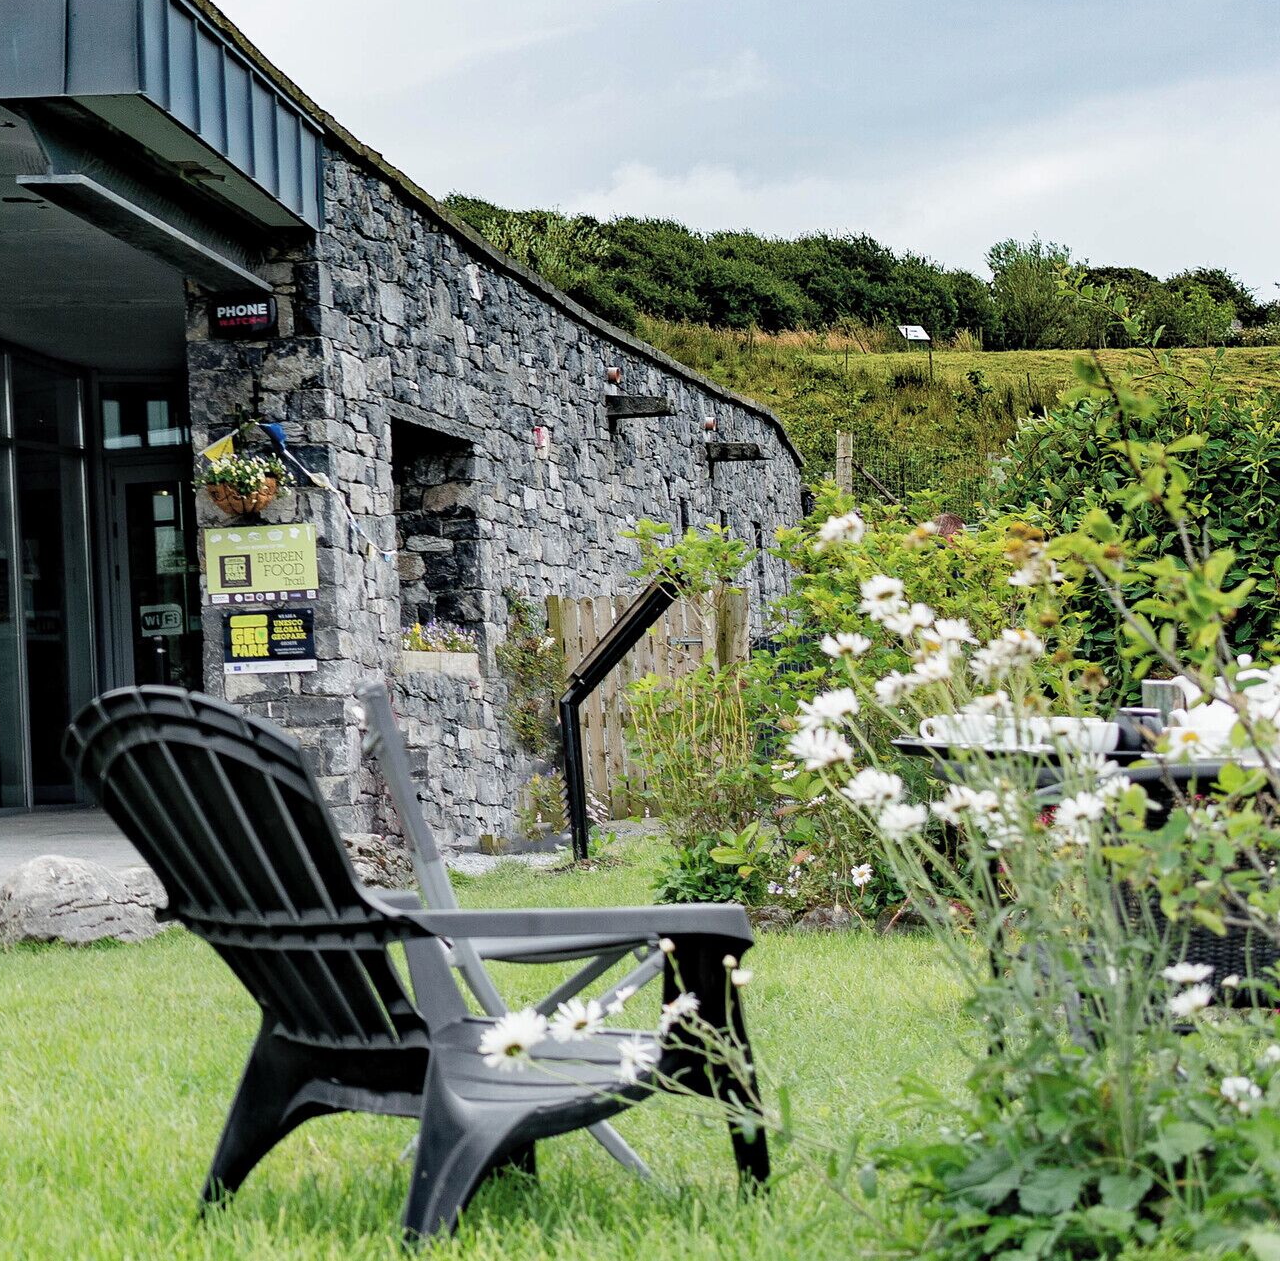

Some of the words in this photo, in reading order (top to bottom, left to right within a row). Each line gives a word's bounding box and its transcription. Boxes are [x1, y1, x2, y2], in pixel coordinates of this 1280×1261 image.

[217, 303, 268, 318] PHONE
[257, 550, 304, 563] BURREN
[264, 563, 305, 577] FOOD
[282, 576, 306, 586] Trail
[273, 619, 304, 627] UNESCO
[273, 625, 304, 634] GLOBAL
[271, 632, 307, 640] GEOPARK
[232, 643, 270, 658] PARK
